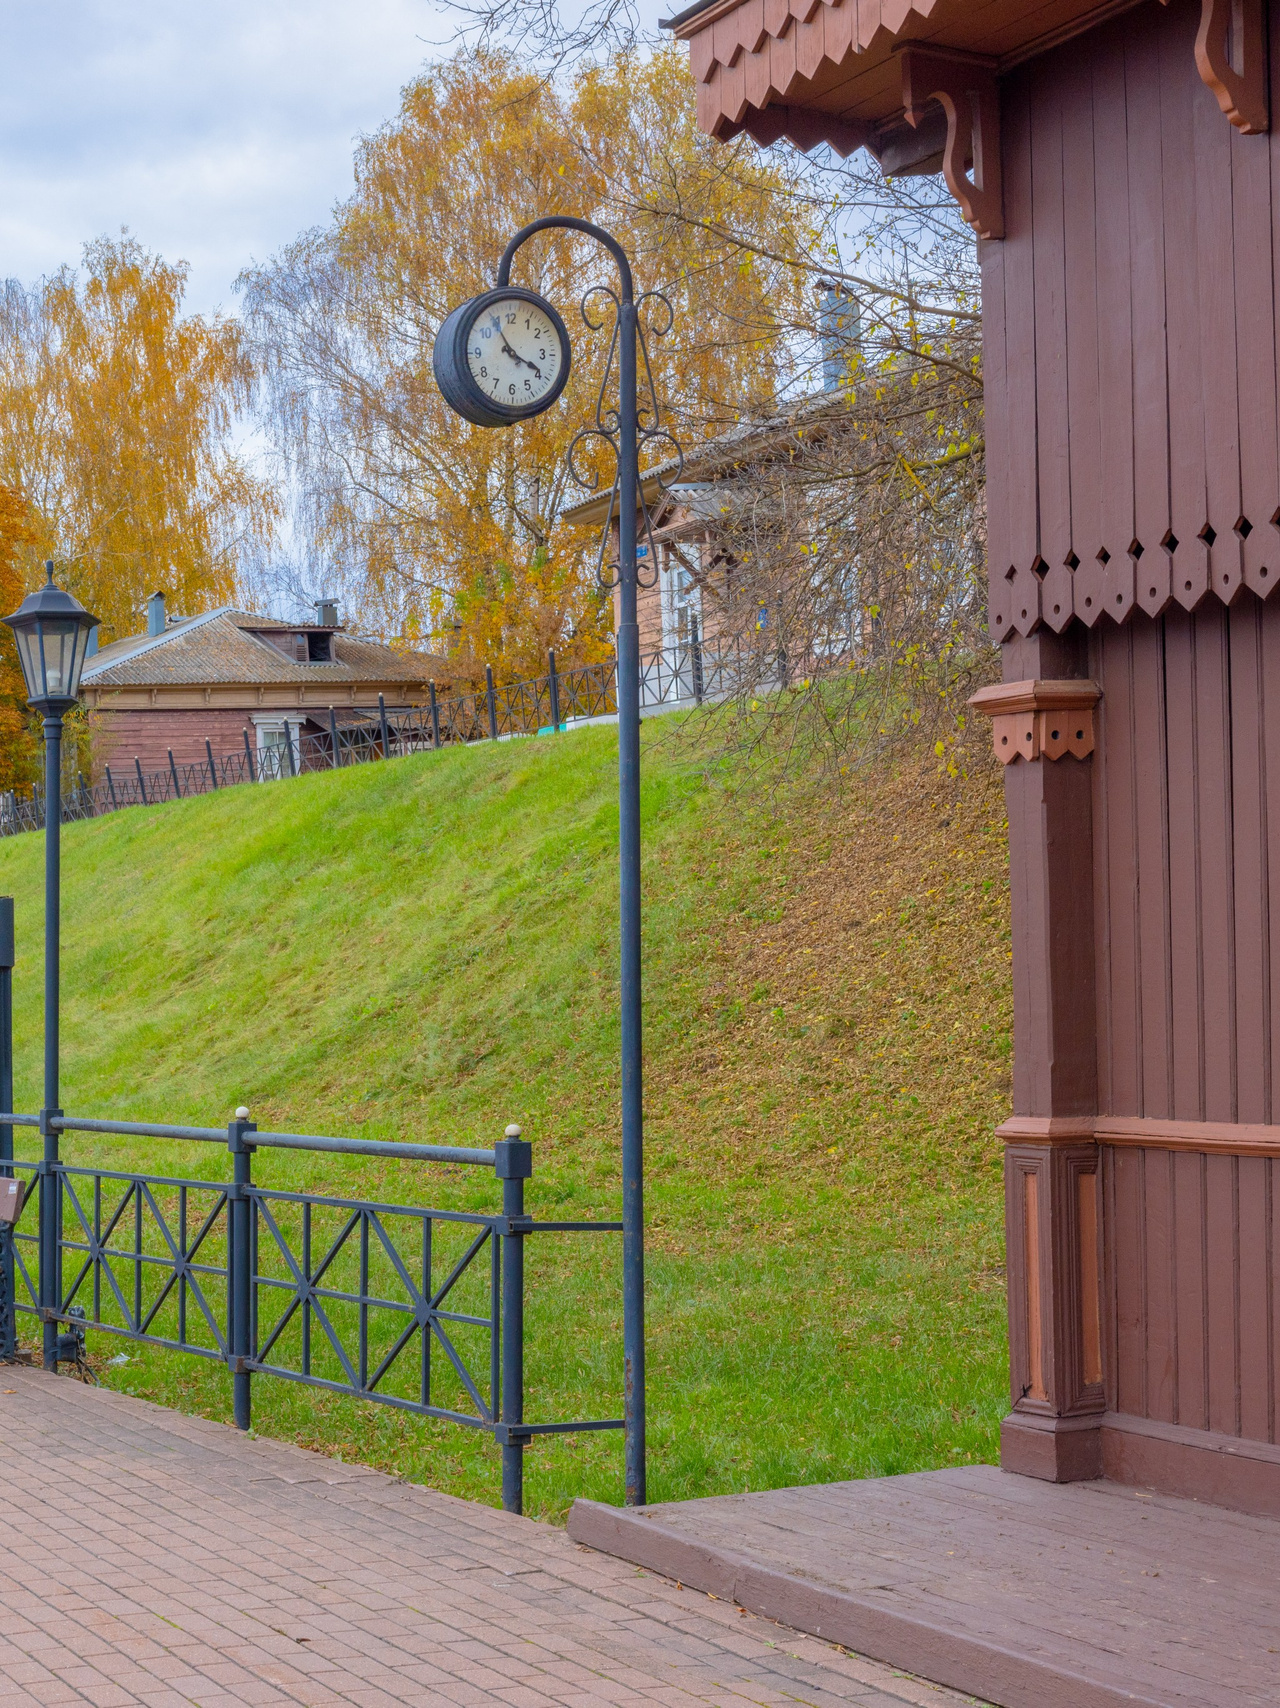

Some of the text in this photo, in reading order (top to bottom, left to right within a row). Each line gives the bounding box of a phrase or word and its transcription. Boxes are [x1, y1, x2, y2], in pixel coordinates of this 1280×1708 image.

[505, 313, 517, 325] 12
[524, 319, 530, 330] 1
[479, 328, 492, 339] 10
[534, 328, 541, 339] 2
[474, 347, 482, 359] 9
[539, 348, 546, 360] 3
[480, 366, 488, 378] 8
[534, 369, 542, 380] 4
[492, 378, 500, 390] 7
[508, 383, 516, 395] 6
[524, 379, 531, 391] 5
